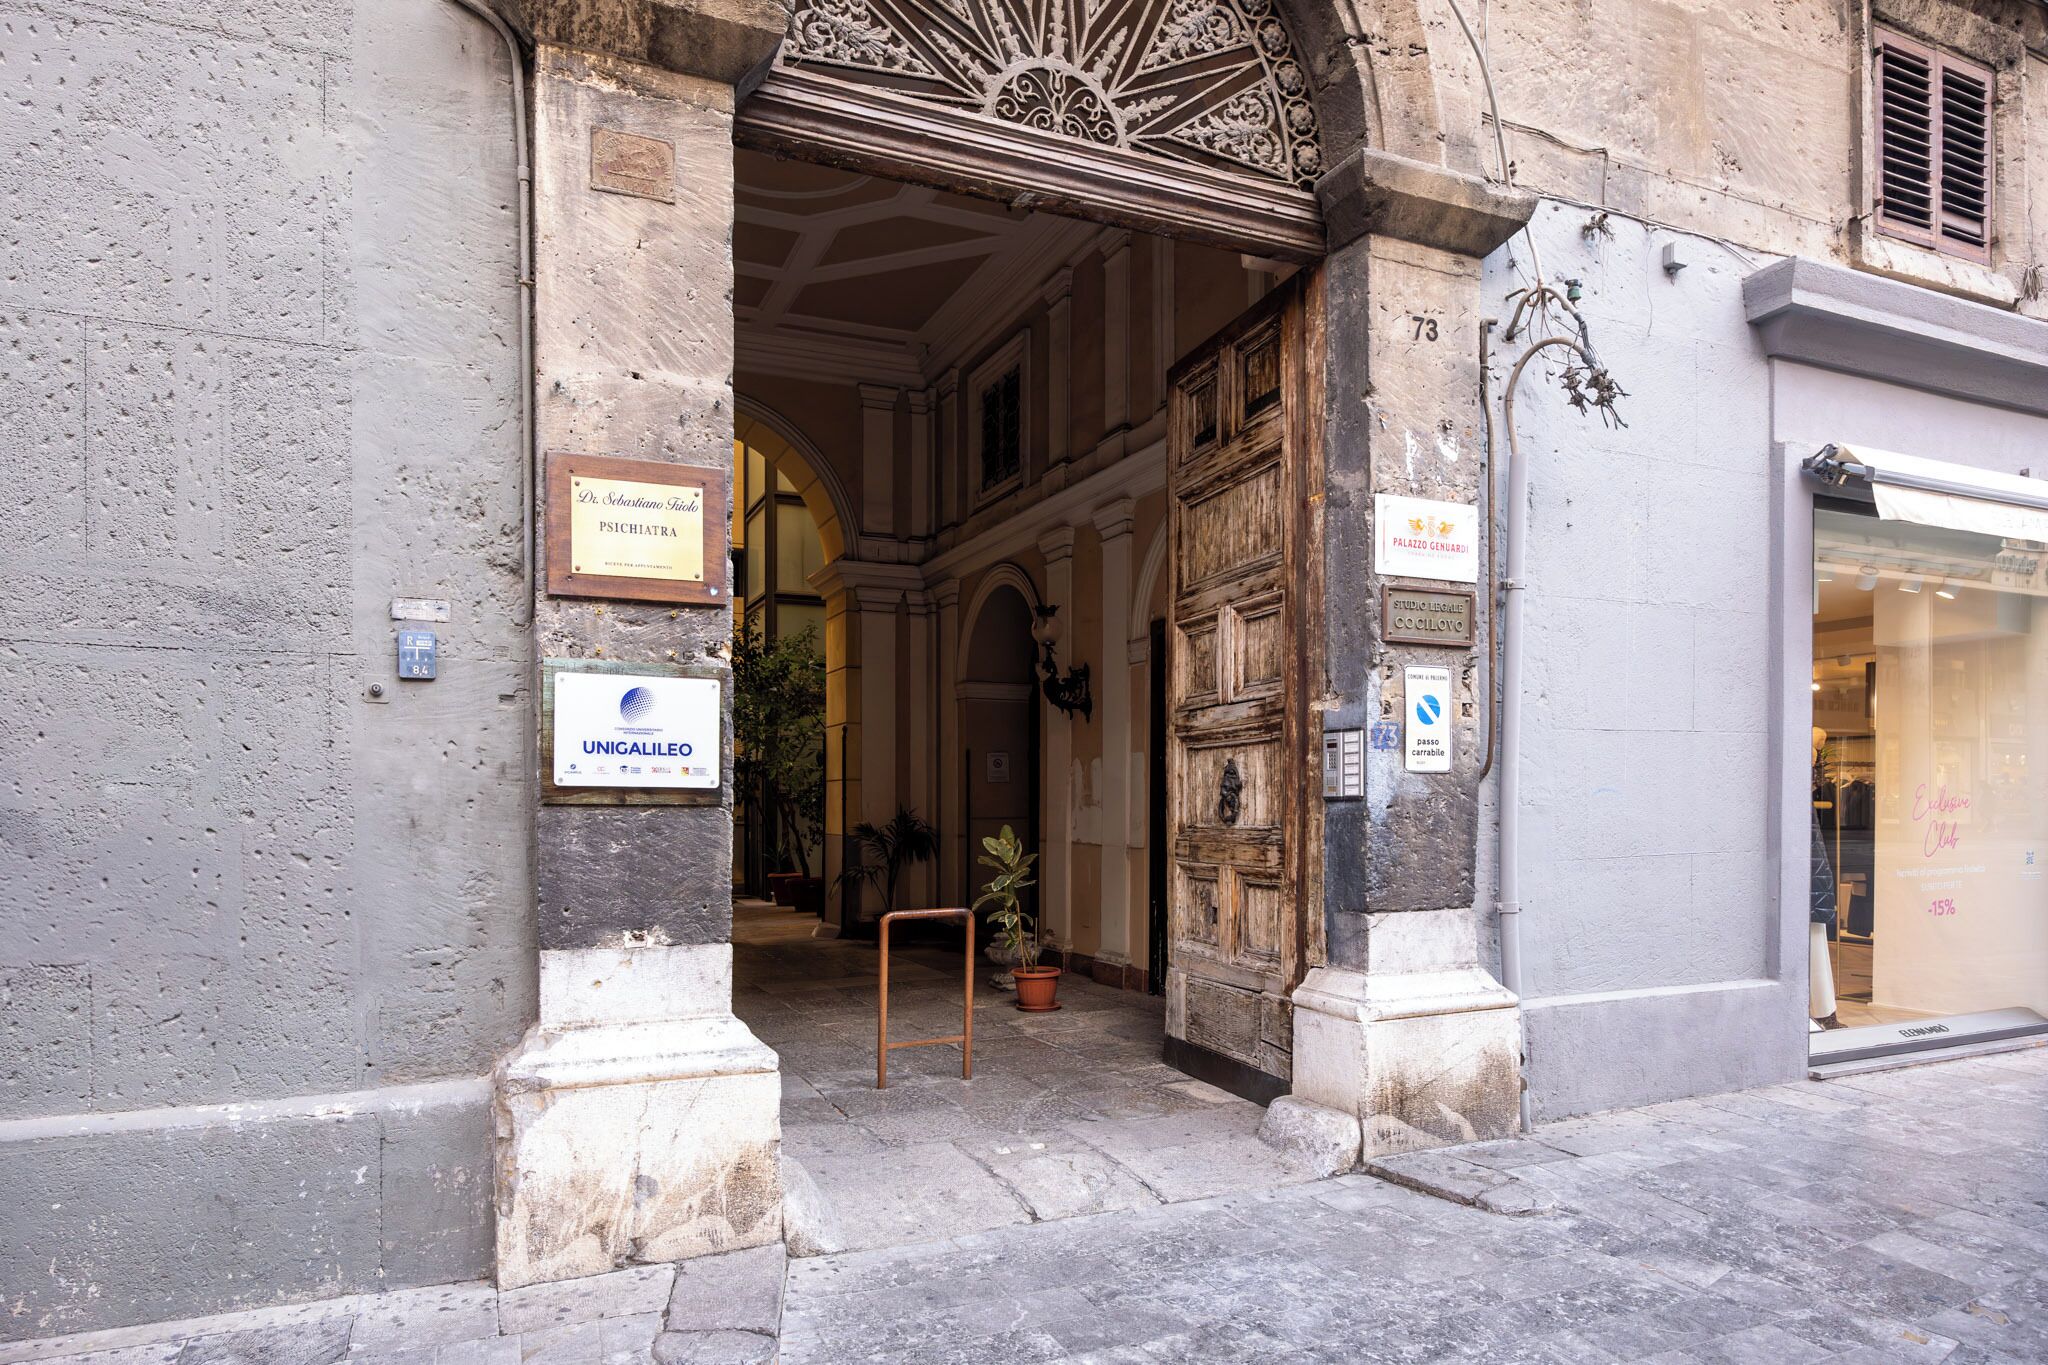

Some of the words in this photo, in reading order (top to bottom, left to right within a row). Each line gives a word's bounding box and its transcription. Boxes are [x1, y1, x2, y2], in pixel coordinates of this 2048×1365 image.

[1412, 316, 1439, 342] 73
[576, 489, 598, 504] Dr.
[602, 490, 663, 510] Sebastiano
[666, 496, 699, 513] Triolo
[599, 521, 677, 538] PSICHIATRA
[1393, 537, 1427, 550] PALAZZO
[1430, 541, 1469, 553] GENUARDI
[1393, 599, 1428, 612] STUDIO
[1429, 601, 1464, 614] LEGALE
[1394, 616, 1464, 633] COCILOVO
[407, 635, 414, 646] R
[1407, 673, 1424, 681] COMUNE
[1377, 724, 1398, 748] 73
[1417, 738, 1439, 747] passo
[583, 741, 693, 757] UNIGALILEO
[1411, 747, 1445, 757] carrabile
[1912, 783, 1970, 822] Exclusive
[1924, 819, 1960, 858] Club
[1927, 898, 1956, 917] -15%
